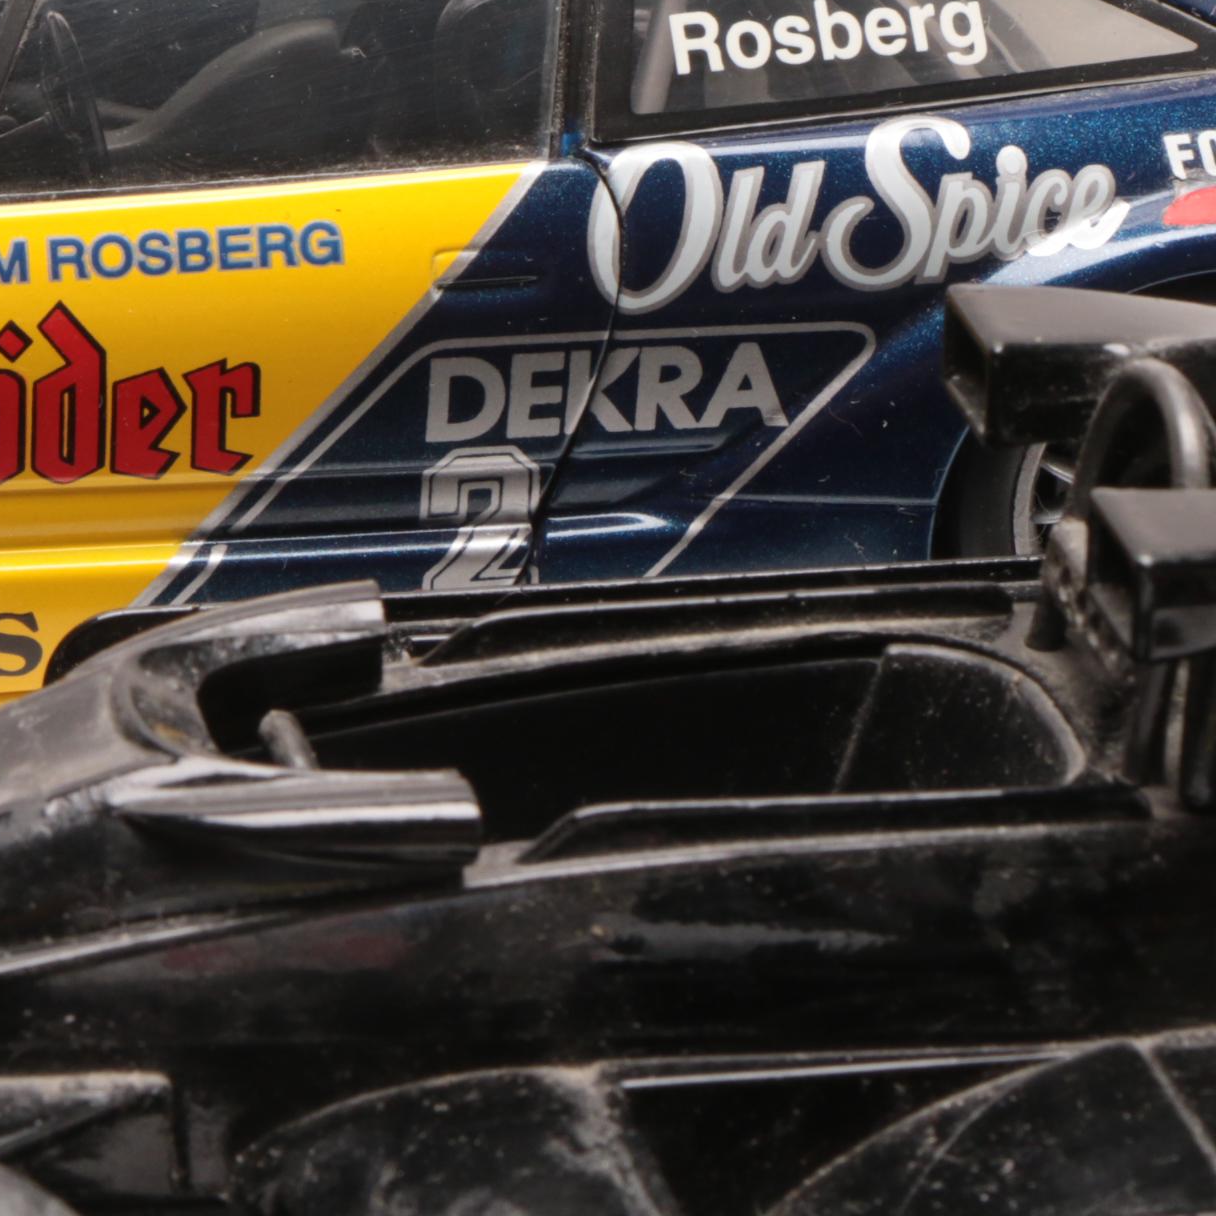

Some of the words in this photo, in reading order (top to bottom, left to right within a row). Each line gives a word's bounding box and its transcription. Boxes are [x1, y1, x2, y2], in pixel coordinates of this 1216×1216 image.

[669, 0, 988, 76] Rosberg
[48, 221, 342, 282] ROSBERG
[587, 142, 829, 315] Old
[821, 115, 1131, 292] Spice
[425, 342, 789, 443] DEKRA
[419, 444, 540, 591] 2
